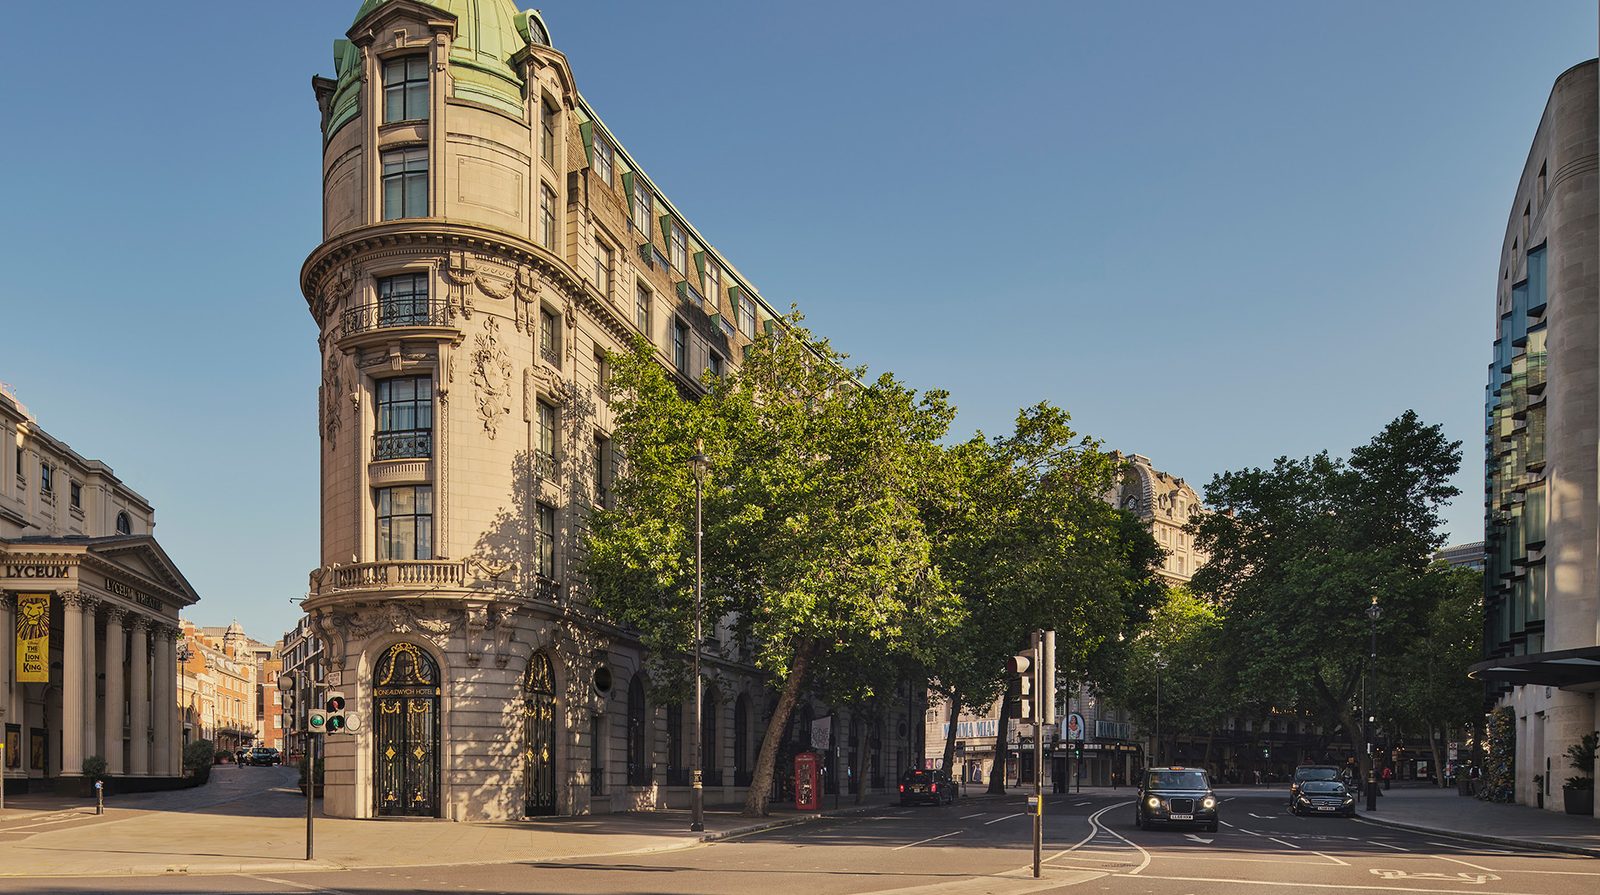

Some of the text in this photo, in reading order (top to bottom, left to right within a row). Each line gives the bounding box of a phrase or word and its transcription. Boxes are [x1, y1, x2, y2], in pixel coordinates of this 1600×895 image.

[6, 566, 69, 578] LYCEUM
[105, 578, 134, 599] LYCEUM
[25, 653, 40, 662] LION
[23, 663, 42, 672] KING
[944, 720, 995, 738] MMMA MIA!
